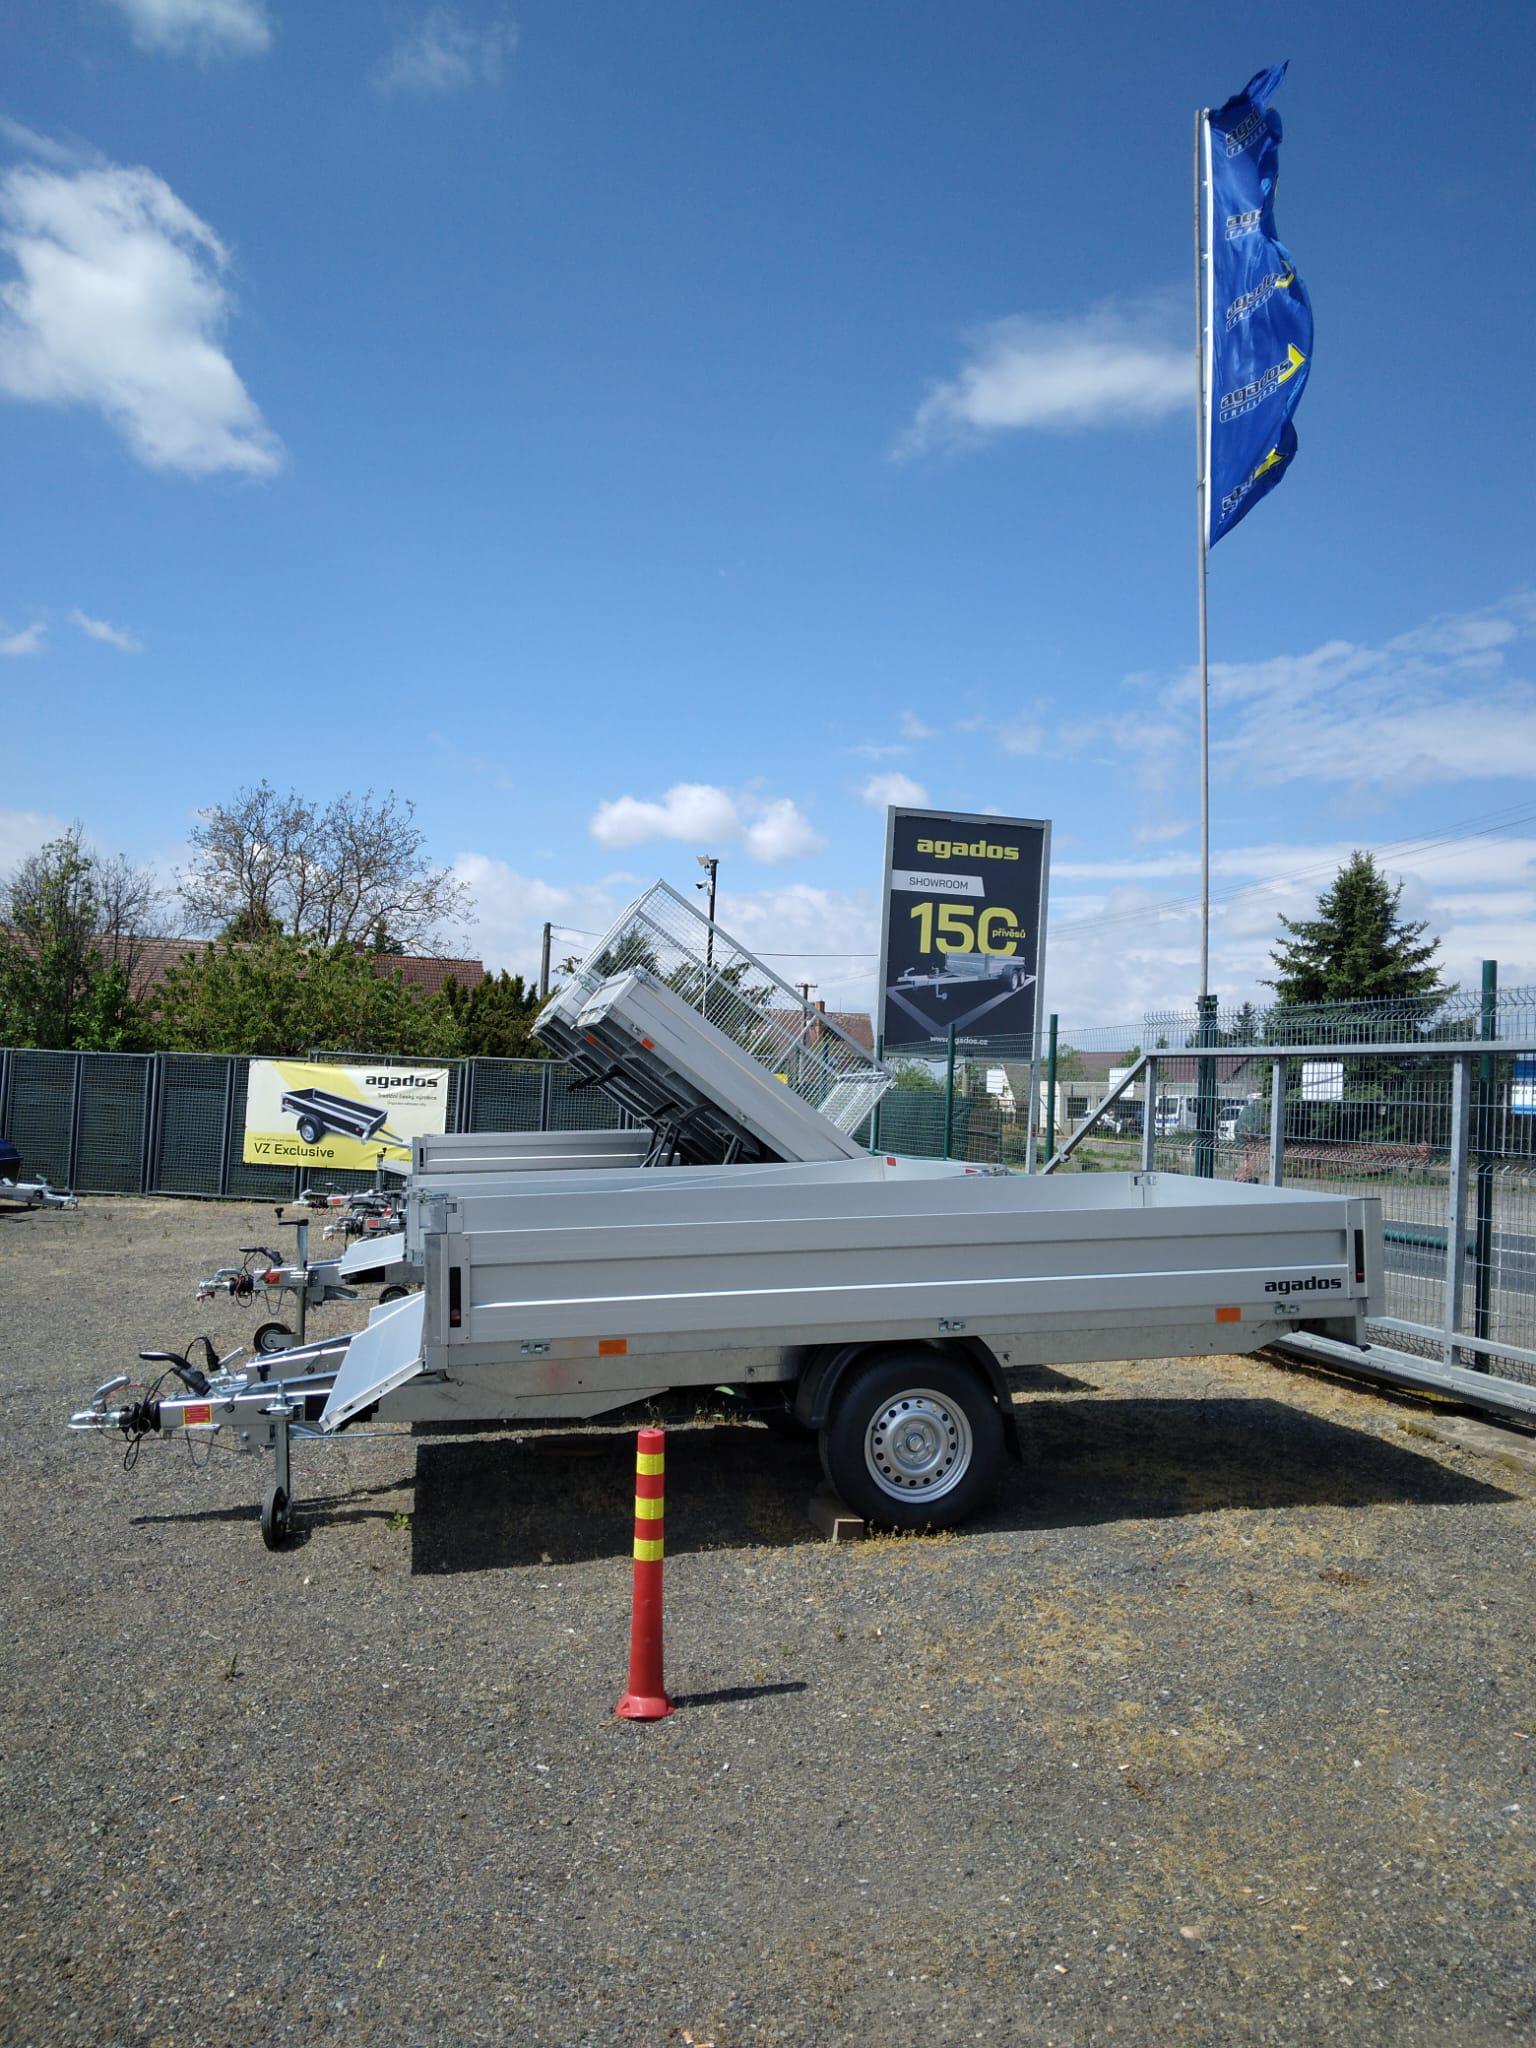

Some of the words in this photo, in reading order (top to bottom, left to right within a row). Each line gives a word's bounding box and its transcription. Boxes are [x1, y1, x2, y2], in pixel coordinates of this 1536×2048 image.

[917, 838, 1020, 861] agados
[909, 876, 969, 890] SHOWROOM
[365, 1074, 438, 1089] agados
[254, 1142, 271, 1154] VZ
[274, 1143, 335, 1158] Exclusive
[1265, 1276, 1342, 1295] agados
